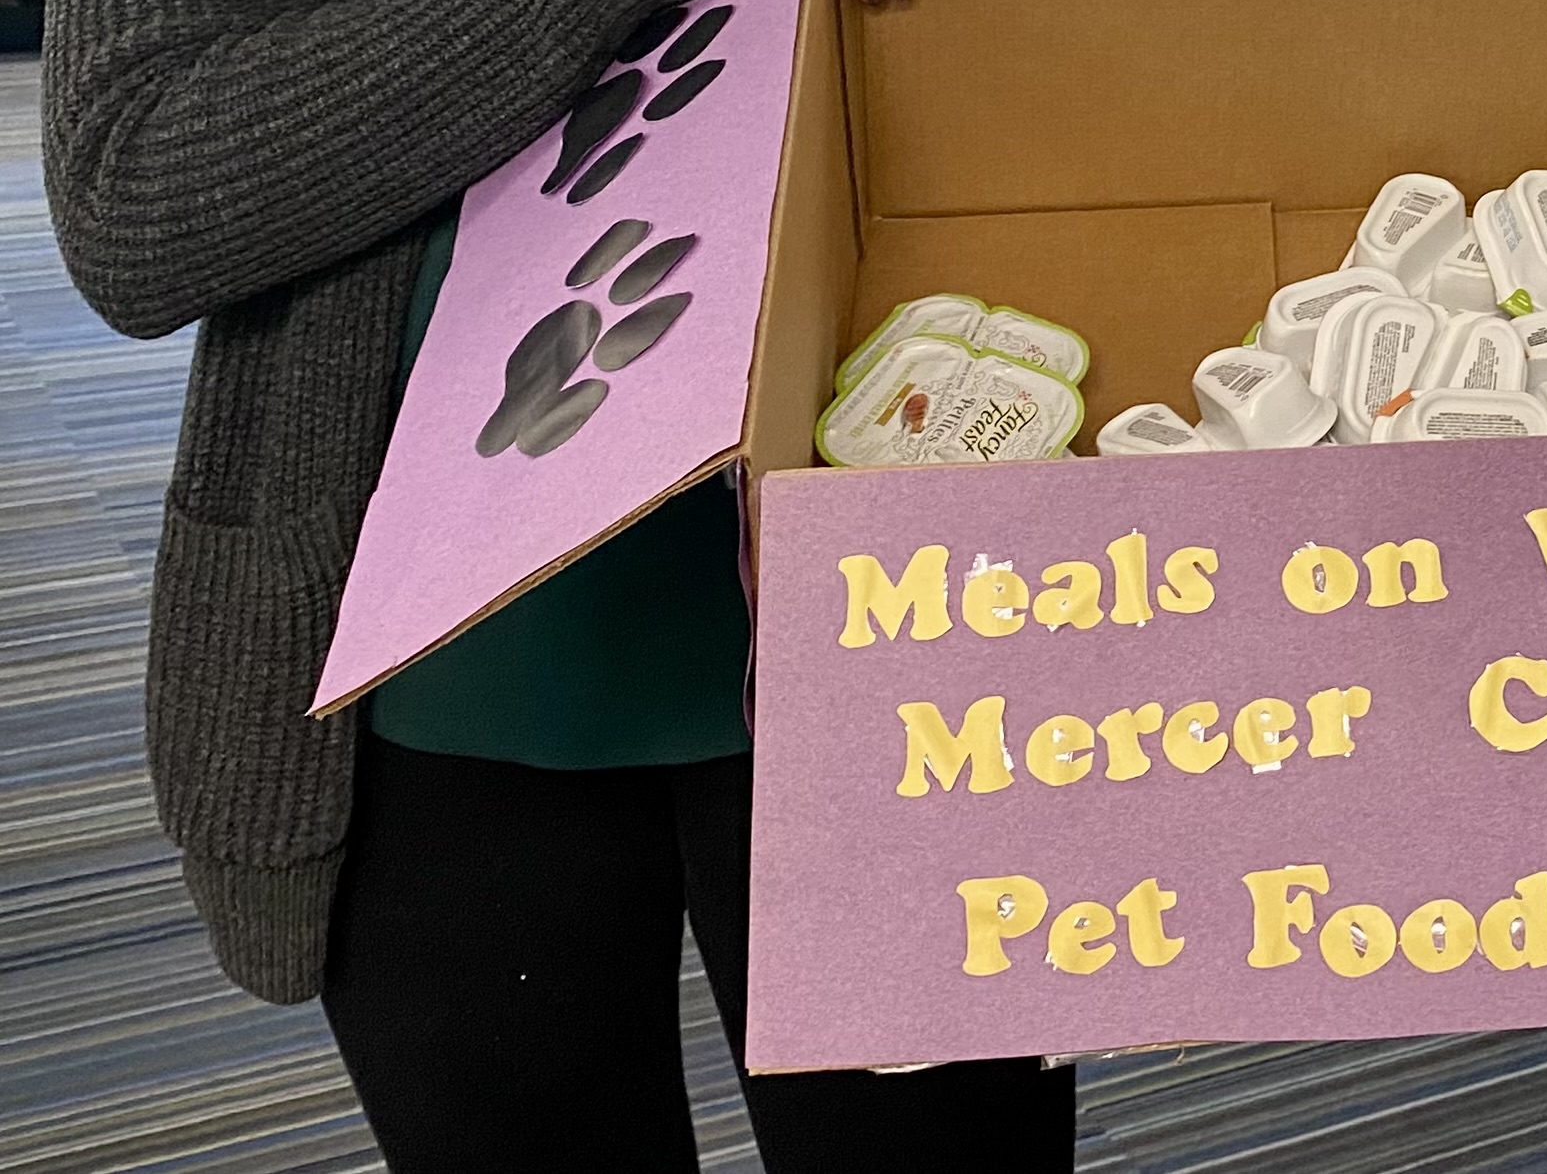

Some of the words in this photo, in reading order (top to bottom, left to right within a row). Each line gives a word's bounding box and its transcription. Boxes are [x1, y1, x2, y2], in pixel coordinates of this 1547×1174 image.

[927, 396, 977, 443] Petites
[960, 398, 1012, 453] Feast
[977, 401, 1038, 462] Fancy
[837, 530, 1220, 648] Meals
[1282, 540, 1449, 613] on
[896, 686, 1372, 797] Mercer
[955, 874, 1185, 977] Pet
